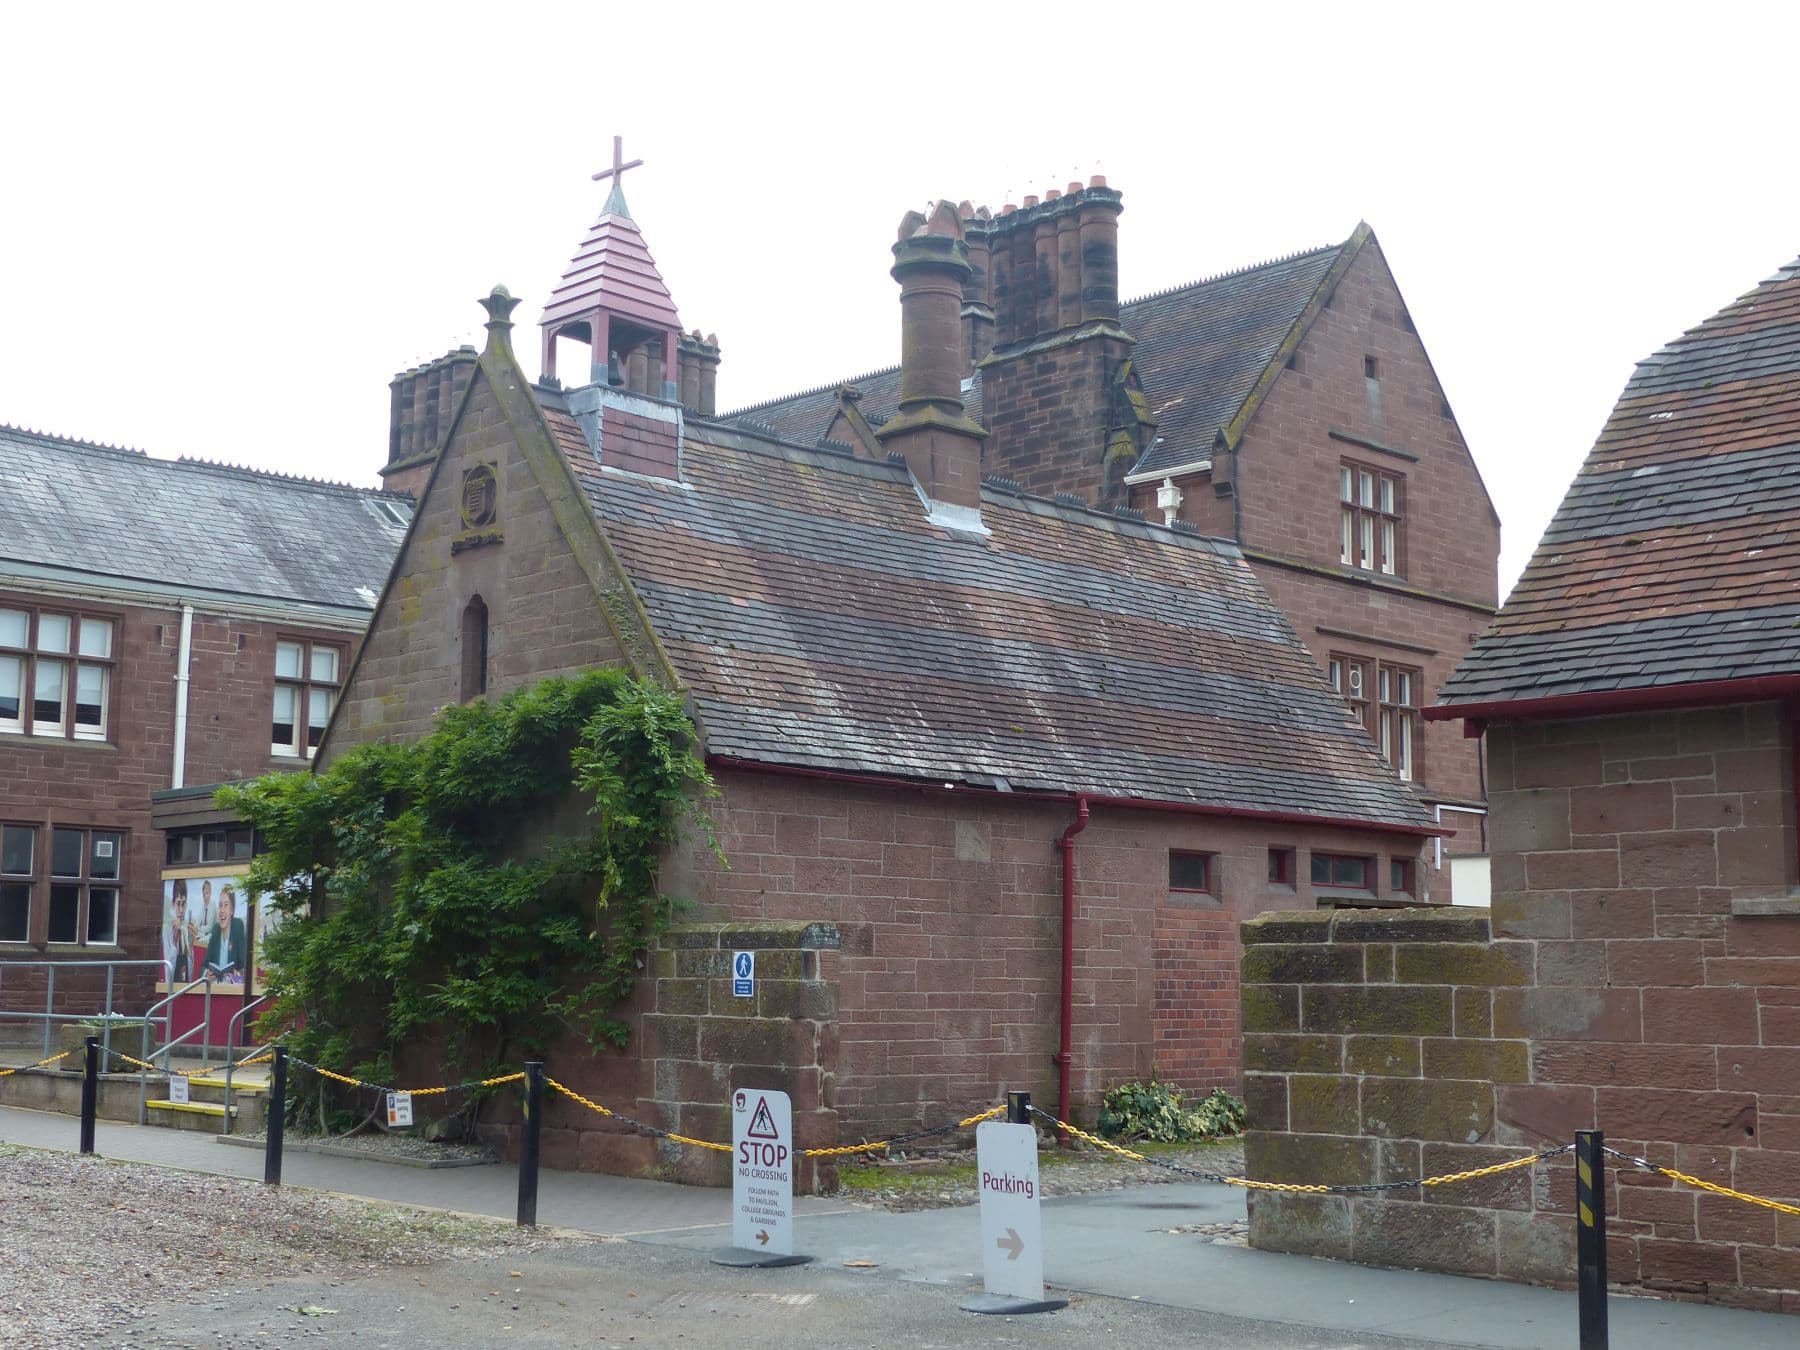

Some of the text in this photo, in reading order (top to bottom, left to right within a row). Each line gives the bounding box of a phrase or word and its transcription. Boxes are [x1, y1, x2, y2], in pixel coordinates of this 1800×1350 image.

[740, 1141, 787, 1168] STOP
[739, 1168, 788, 1181] NO CROSSING
[748, 1187, 766, 1195] FOLLOW
[983, 1172, 1033, 1199] Parking
[763, 1208, 785, 1217] GROUNDS
[755, 1217, 776, 1225] GARDENS
